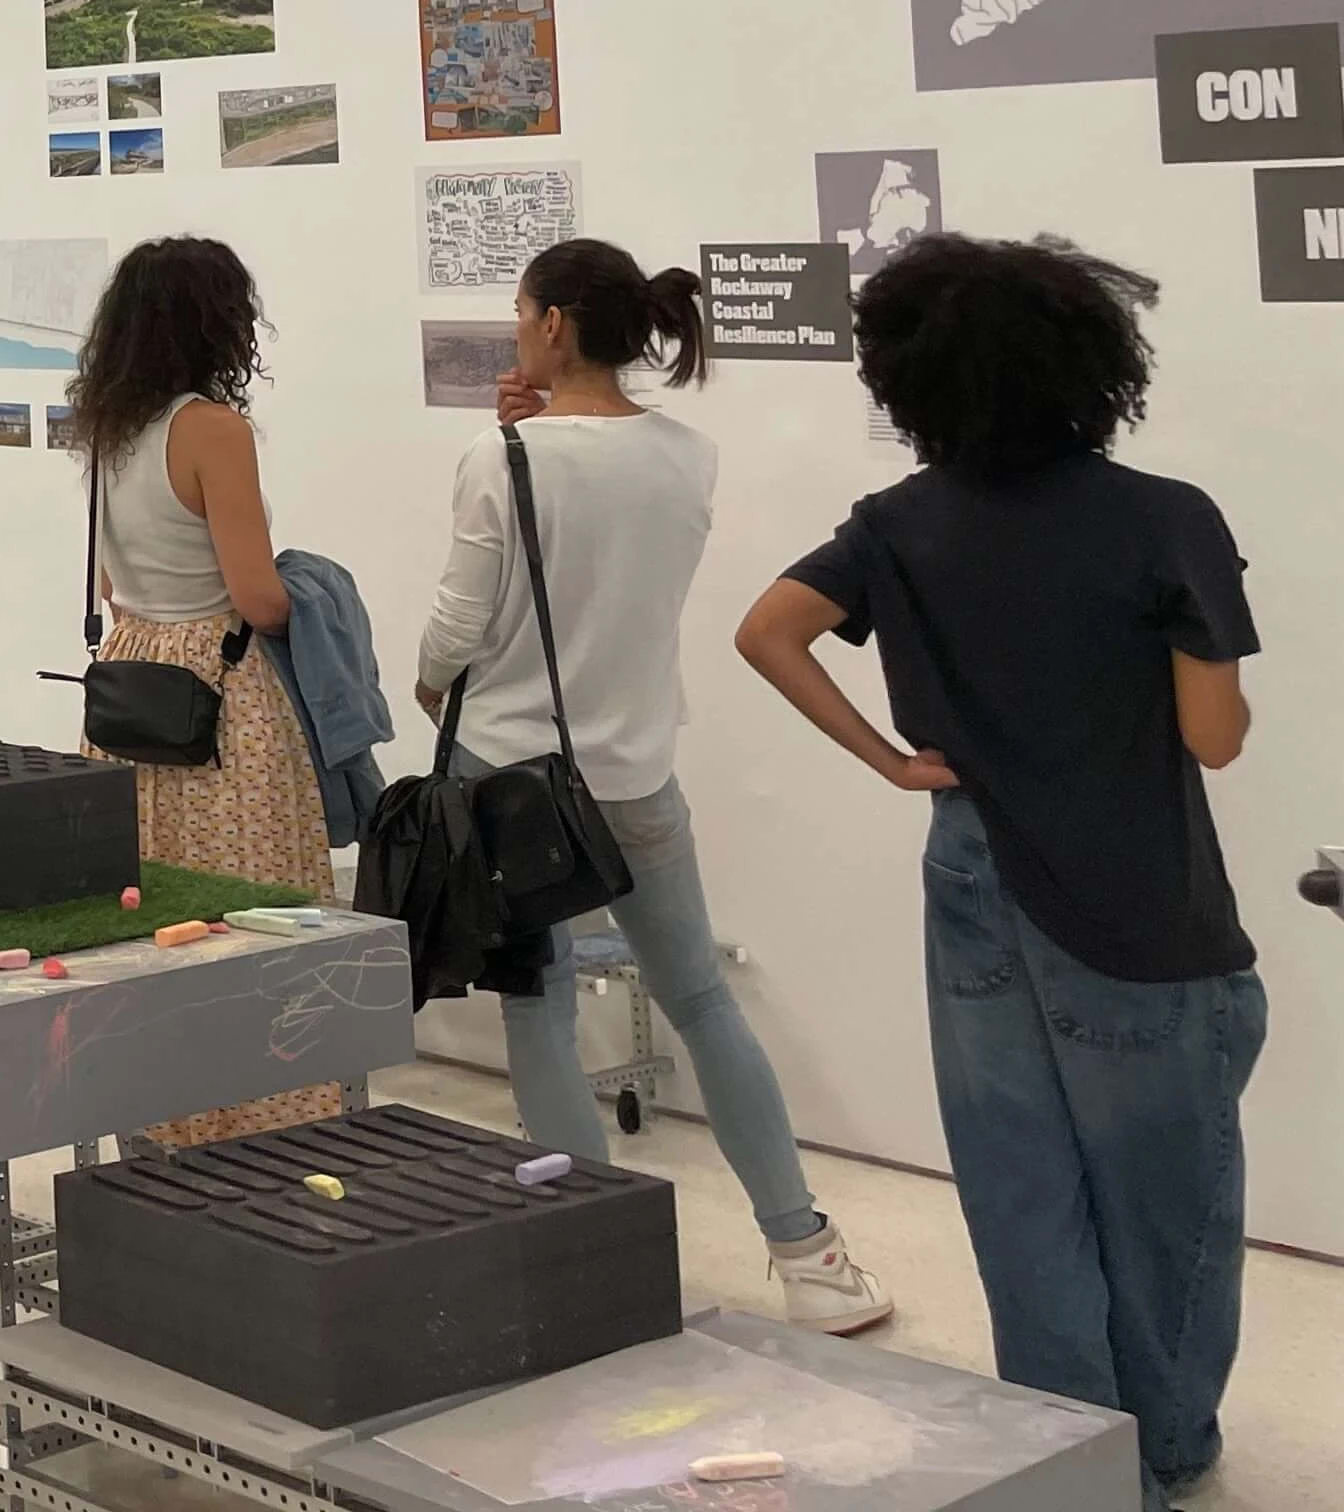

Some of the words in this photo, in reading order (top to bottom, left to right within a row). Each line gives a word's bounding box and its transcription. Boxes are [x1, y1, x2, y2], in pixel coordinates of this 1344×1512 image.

[1195, 67, 1298, 123] CON
[1303, 208, 1344, 260] N
[710, 253, 739, 272] The
[740, 253, 807, 273] Greater
[711, 277, 793, 300] Rockaway
[712, 301, 774, 320] Coastal
[714, 325, 796, 345] Resilience
[797, 326, 836, 345] Plan
